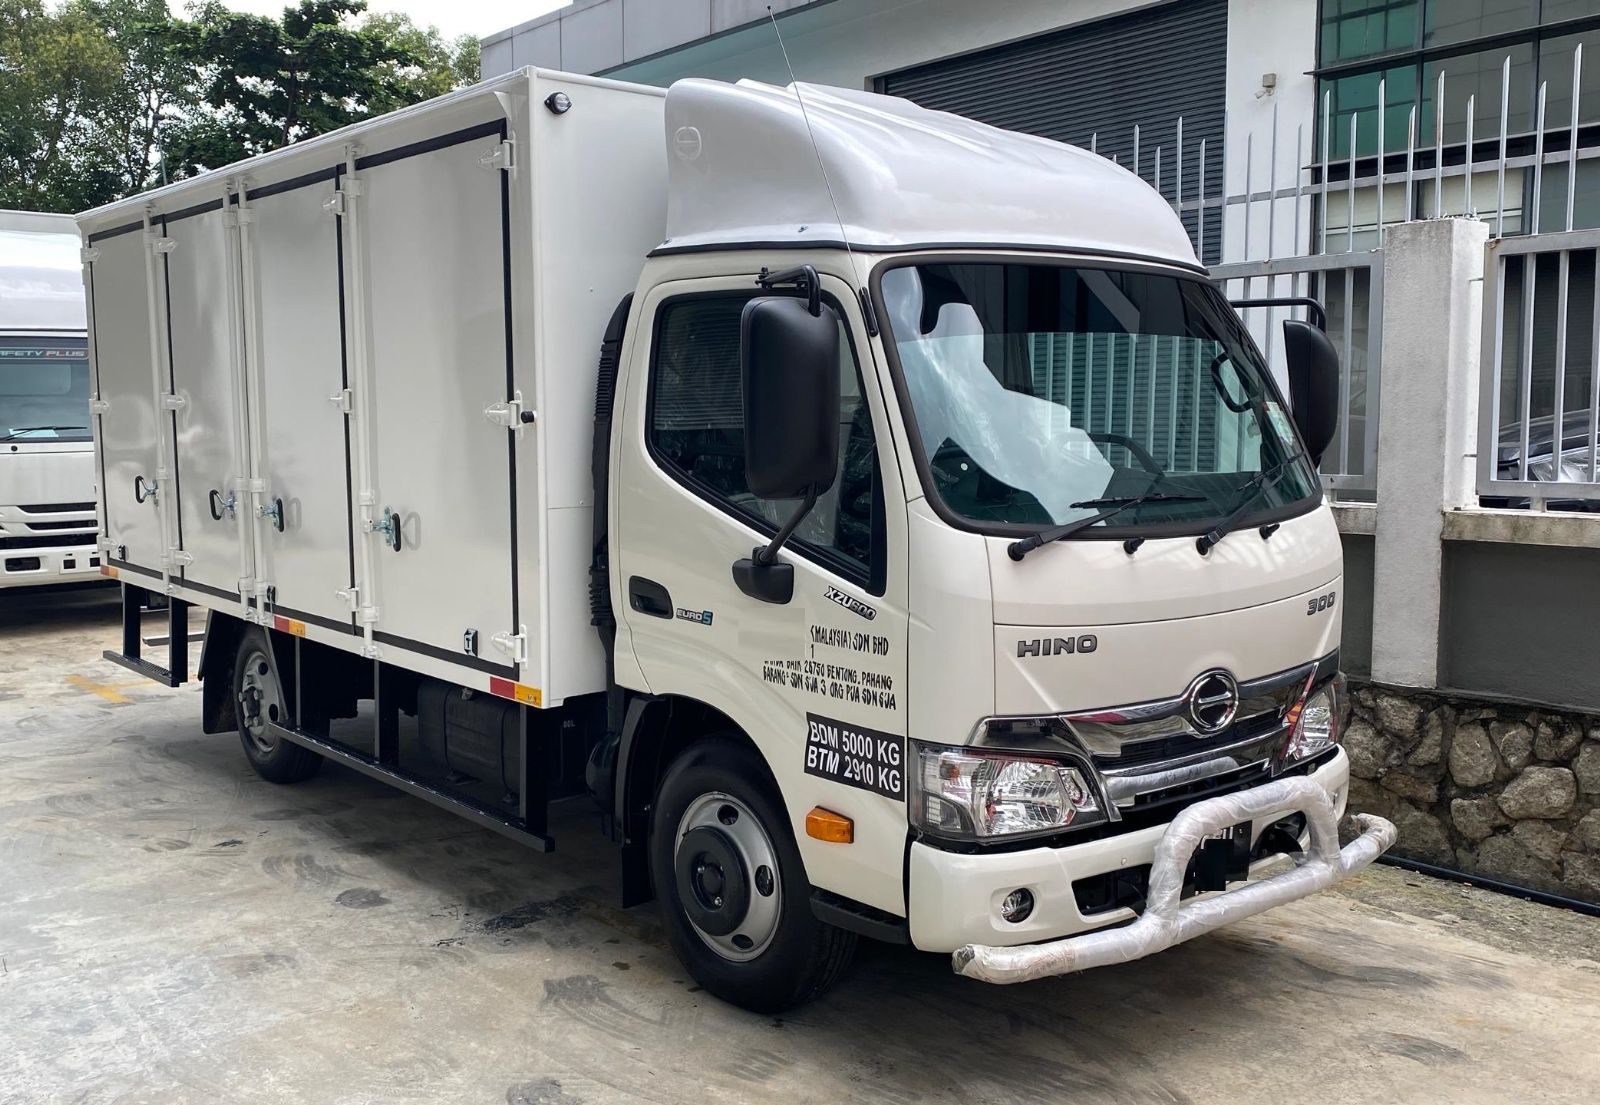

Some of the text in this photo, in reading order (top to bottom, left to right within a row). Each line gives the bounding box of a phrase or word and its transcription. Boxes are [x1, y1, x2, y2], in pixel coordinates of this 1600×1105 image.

[825, 586, 876, 620] XZU600
[1307, 591, 1335, 616] 300
[853, 633, 870, 653] SDN
[872, 636, 889, 656] BHD
[1017, 634, 1098, 658] HINO
[820, 679, 827, 696] 3
[861, 688, 878, 706] SDN
[861, 671, 893, 691] PAHANG
[809, 721, 900, 766] BDM 5000 KG
[807, 745, 901, 793] BTM 2910 KG
